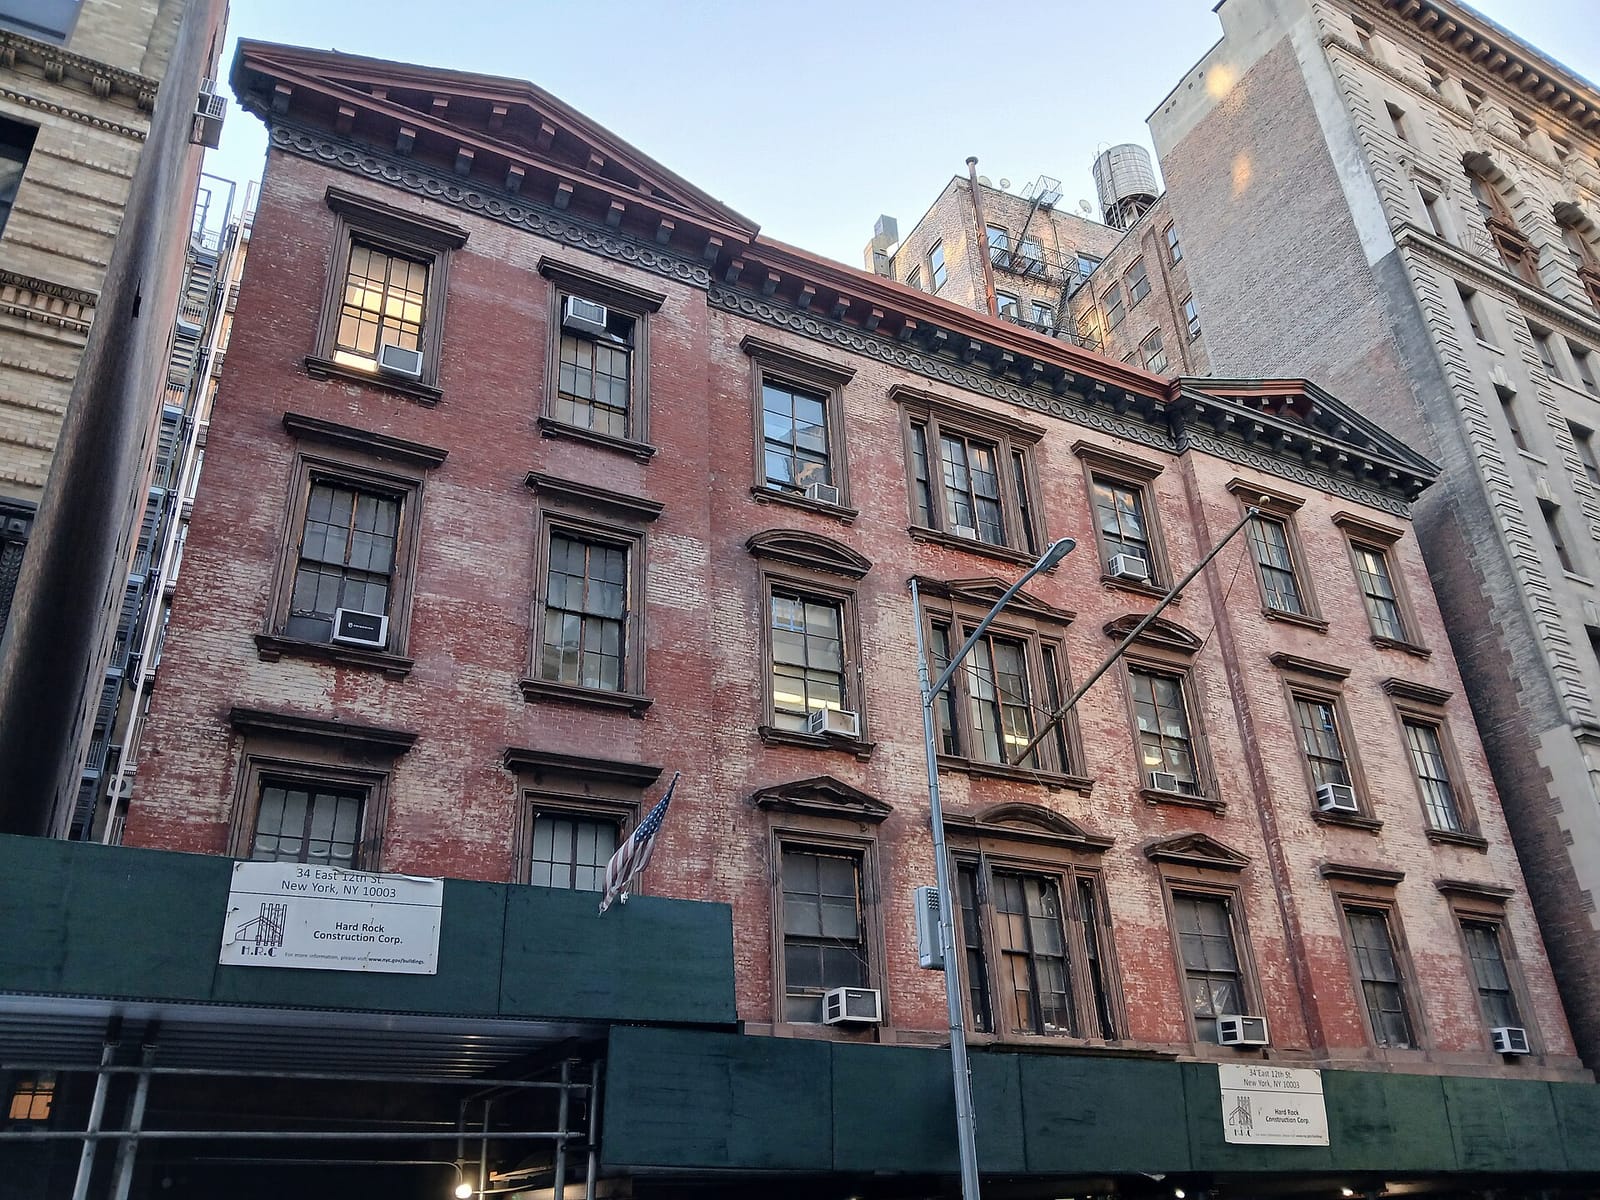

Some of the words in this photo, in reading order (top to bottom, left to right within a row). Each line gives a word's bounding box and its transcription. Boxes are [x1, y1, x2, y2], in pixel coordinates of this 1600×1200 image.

[296, 868, 310, 878] 34
[315, 870, 337, 881] East
[342, 872, 366, 882] 12th
[371, 875, 384, 884] St.
[281, 880, 307, 891] New
[312, 882, 338, 894] York,
[343, 885, 359, 895] NY
[363, 887, 396, 898] 10003
[335, 922, 359, 931] Hard
[362, 923, 385, 933] Rock
[313, 930, 375, 942] Construction
[378, 935, 403, 945] Corp.
[1243, 1078, 1257, 1086] New
[1273, 1080, 1281, 1088] NY
[1265, 1115, 1296, 1123] Construction
